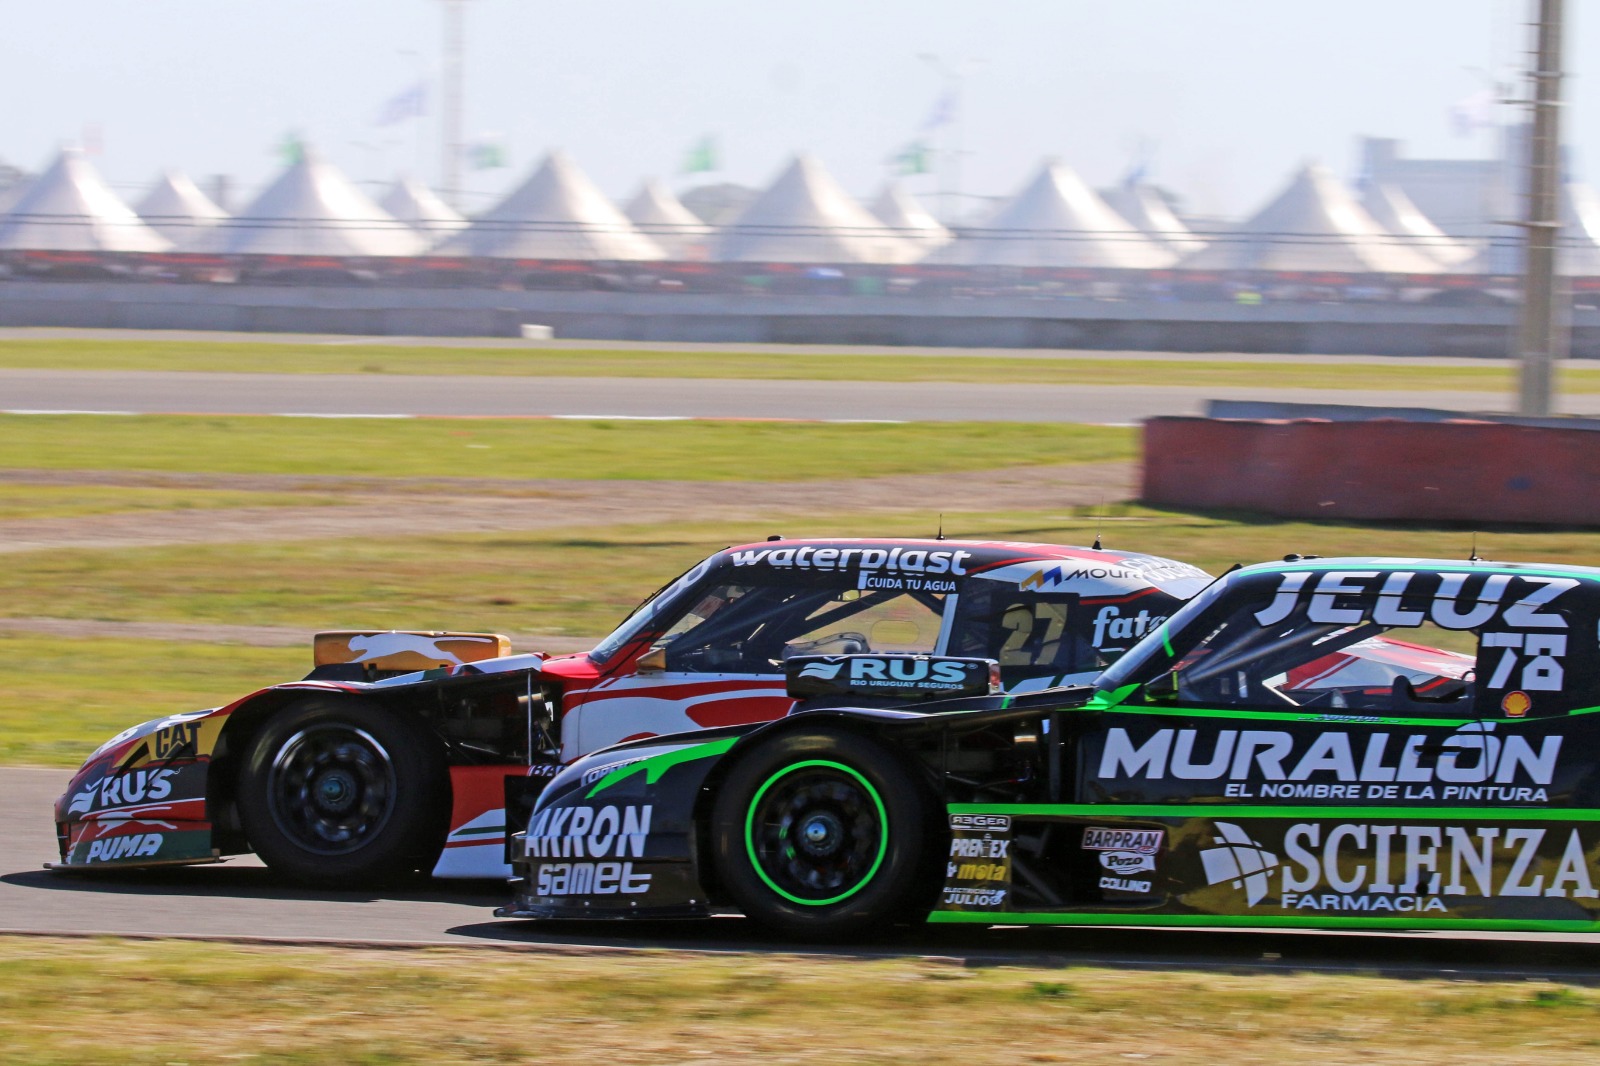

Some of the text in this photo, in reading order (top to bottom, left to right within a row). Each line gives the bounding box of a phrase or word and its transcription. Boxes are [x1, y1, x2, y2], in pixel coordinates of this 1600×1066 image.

[730, 547, 971, 590] waterplast
[867, 577, 957, 591] CUIDA TU AGUA
[1253, 571, 1581, 629] JELUZ
[1001, 603, 1068, 667] 27
[850, 658, 966, 683] RUS
[1482, 632, 1568, 691] 78
[869, 680, 915, 688] URUGUAY
[917, 681, 965, 690] SEGUROS
[155, 721, 201, 759] CAT
[1098, 721, 1563, 785] MURALLÓN
[101, 768, 174, 806] RUS
[1224, 784, 1549, 802] EL NOMBRE DE LA PINTURA
[86, 833, 164, 864] PUMA
[525, 805, 653, 858] AKRON
[1085, 831, 1158, 848] BARPRAN
[537, 862, 652, 896] samet
[1281, 822, 1599, 899] SCIENZA
[1281, 893, 1448, 913] FARMACIA
